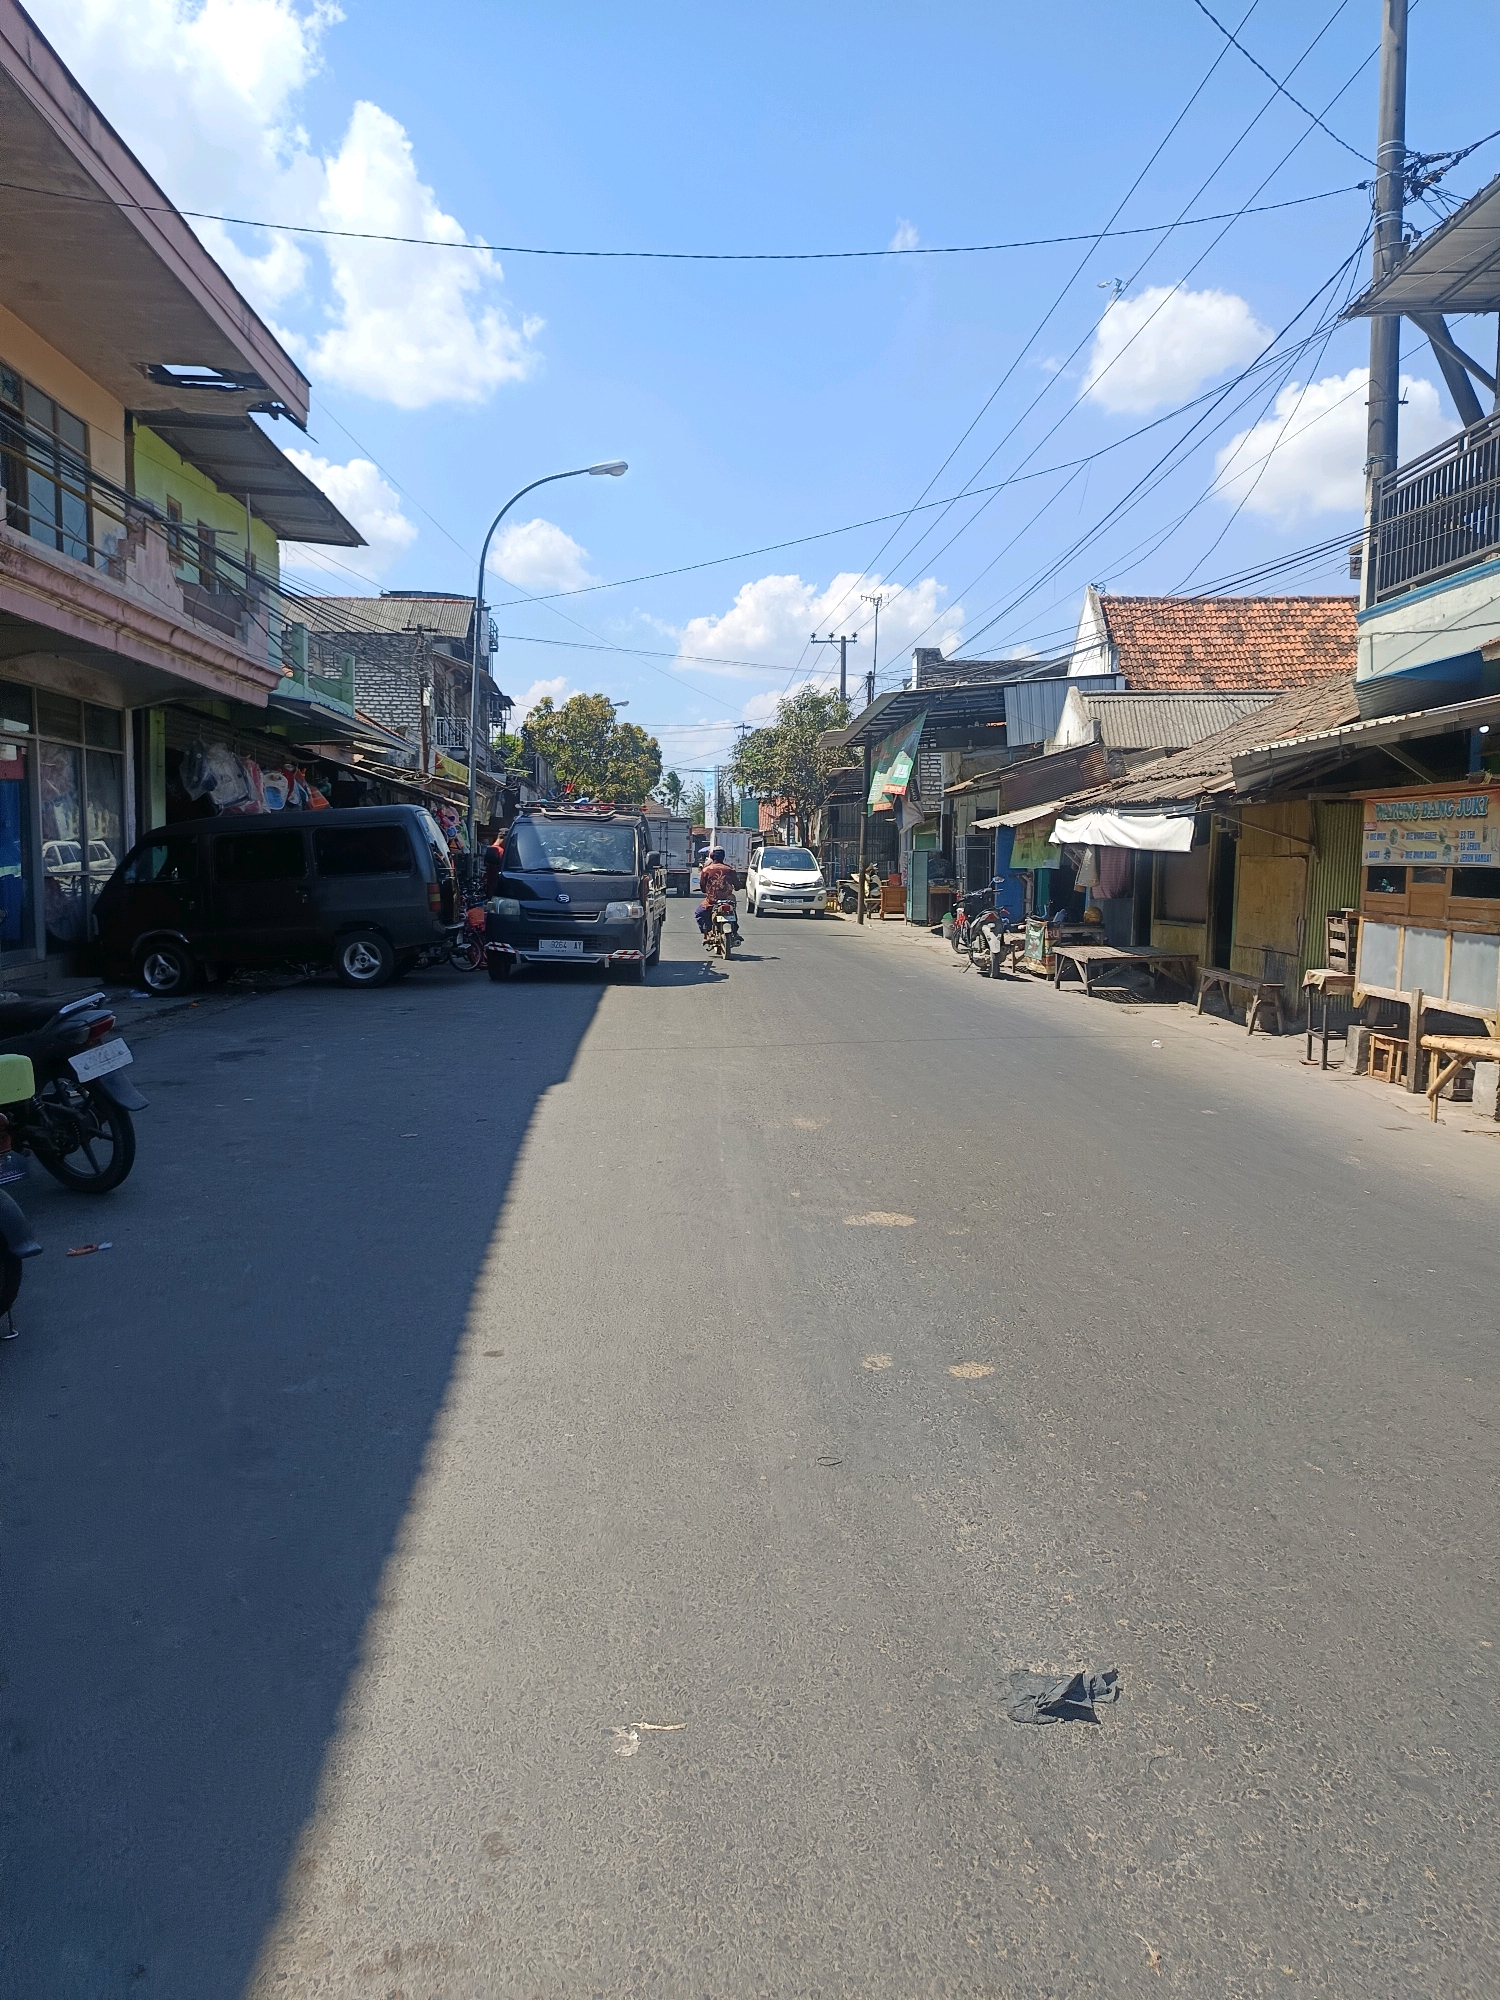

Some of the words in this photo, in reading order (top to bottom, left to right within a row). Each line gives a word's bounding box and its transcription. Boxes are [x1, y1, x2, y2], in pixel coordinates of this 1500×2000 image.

[1375, 801, 1420, 821] WARUNG
[1420, 798, 1455, 819] BANG
[1456, 795, 1489, 817] JUKI
[540, 941, 544, 949] L
[550, 941, 567, 949] 9264
